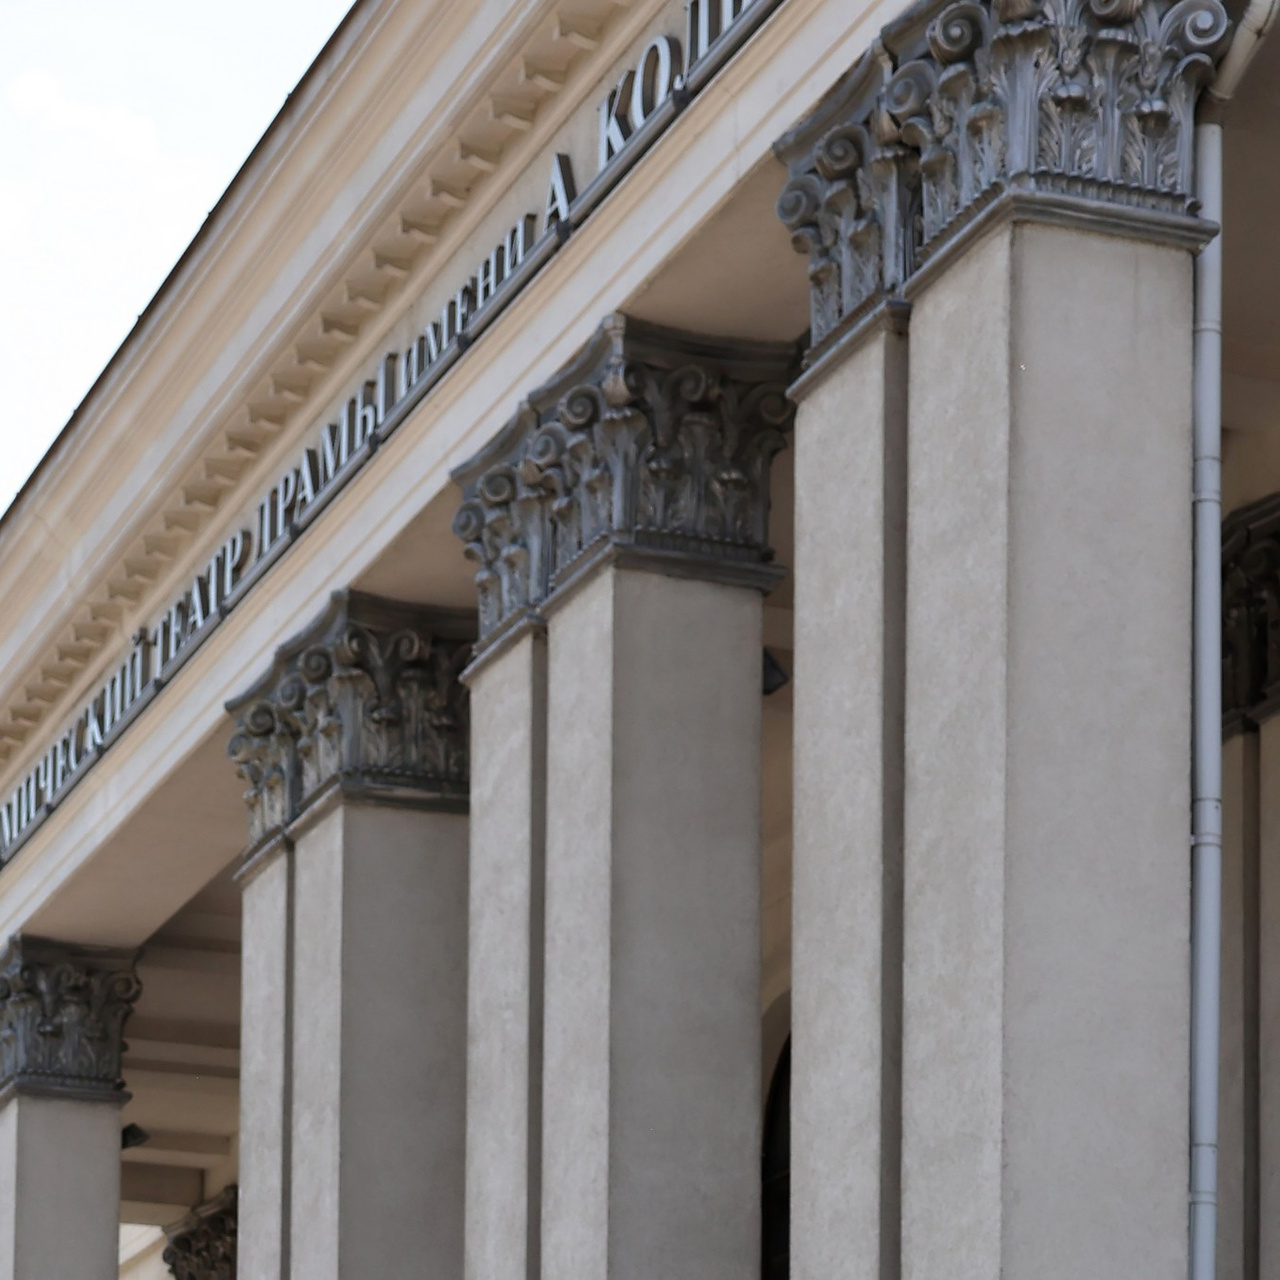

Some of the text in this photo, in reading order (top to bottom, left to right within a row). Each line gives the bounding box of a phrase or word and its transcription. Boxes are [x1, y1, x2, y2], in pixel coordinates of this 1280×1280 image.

[153, 530, 245, 679] ТЕАТР
[254, 354, 388, 564] ДРАМЫ
[401, 214, 527, 397] ИМЕНИ
